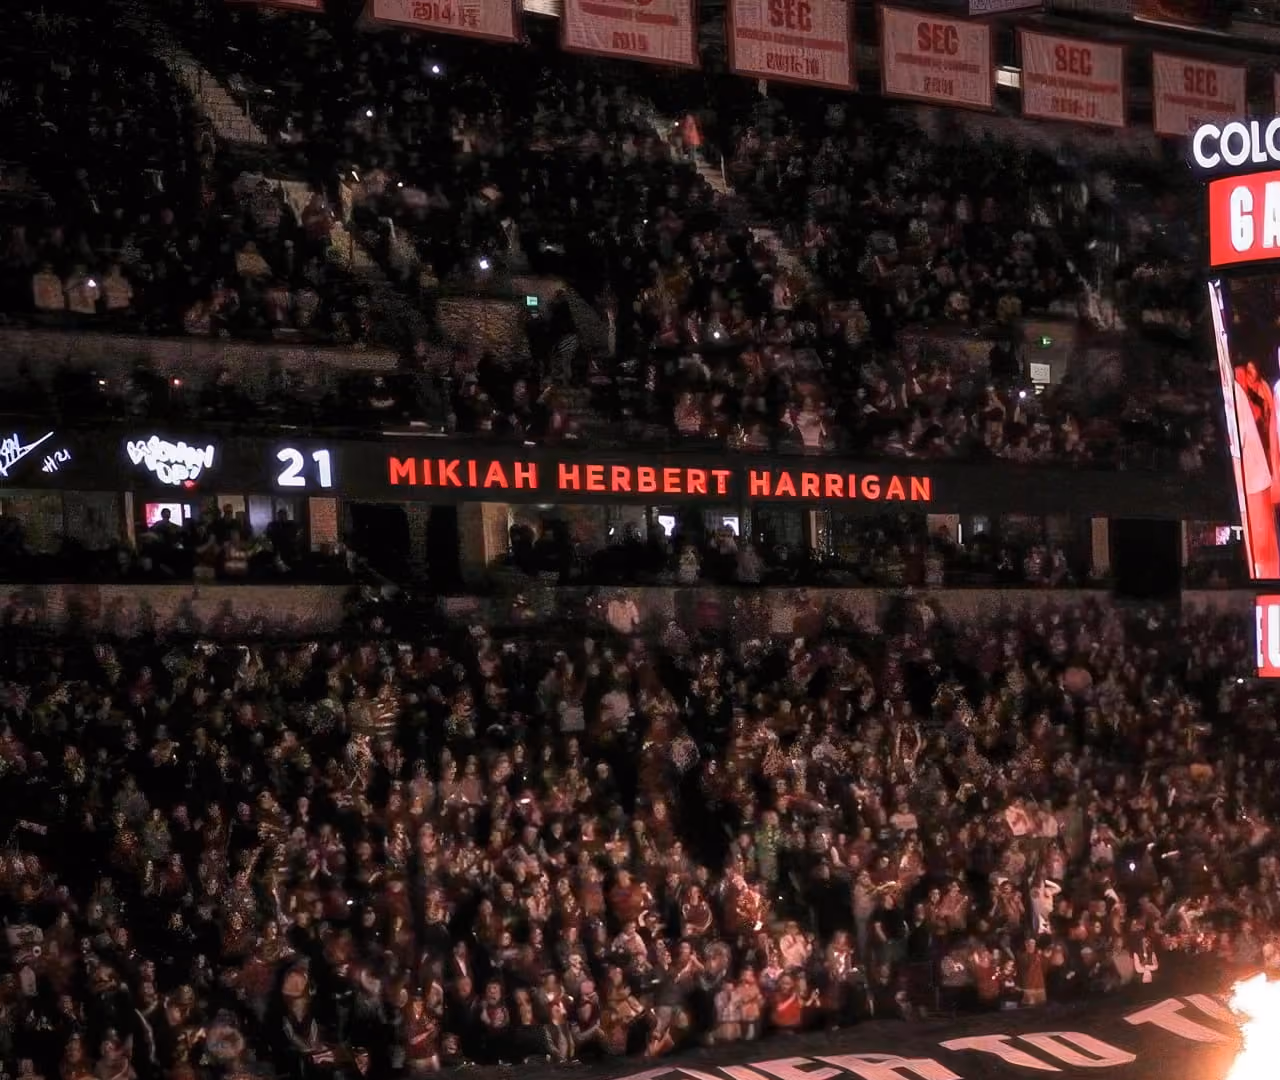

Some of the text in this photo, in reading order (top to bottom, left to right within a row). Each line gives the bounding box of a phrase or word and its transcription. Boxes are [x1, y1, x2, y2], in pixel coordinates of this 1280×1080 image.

[917, 22, 960, 55] SEC
[1055, 44, 1094, 76] SEC
[276, 446, 333, 488] 21
[388, 456, 932, 501] MIKIAH HERBERT HARRIGAN
[938, 1030, 1137, 1072] TO
